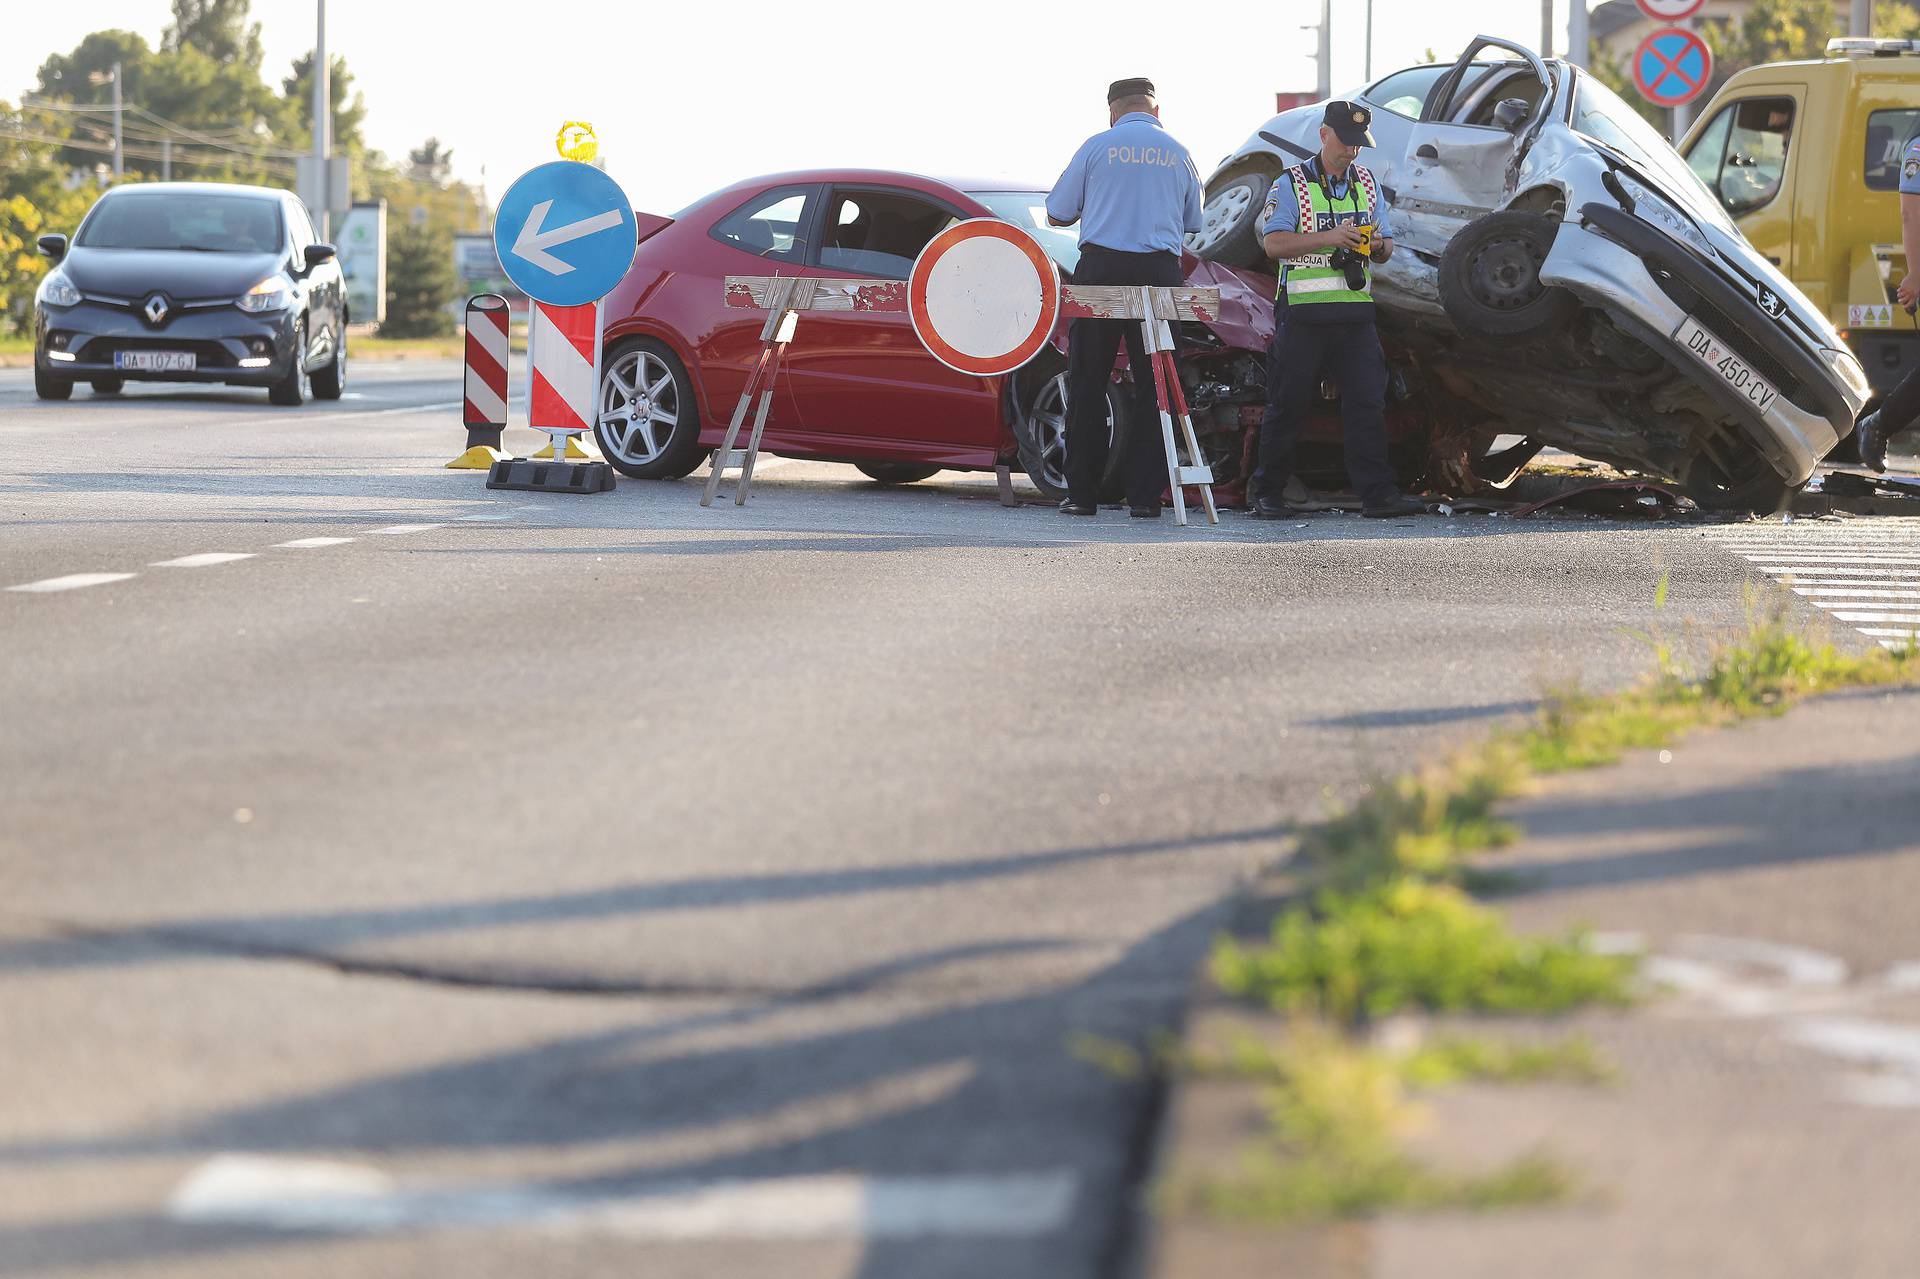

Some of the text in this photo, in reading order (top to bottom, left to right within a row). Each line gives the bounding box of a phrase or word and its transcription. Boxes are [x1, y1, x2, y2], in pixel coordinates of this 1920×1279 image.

[1108, 146, 1179, 168] POLICIJA
[1289, 255, 1323, 265] OLICIJA
[123, 353, 138, 368] DA
[1688, 329, 1775, 407] DA 450-CV
